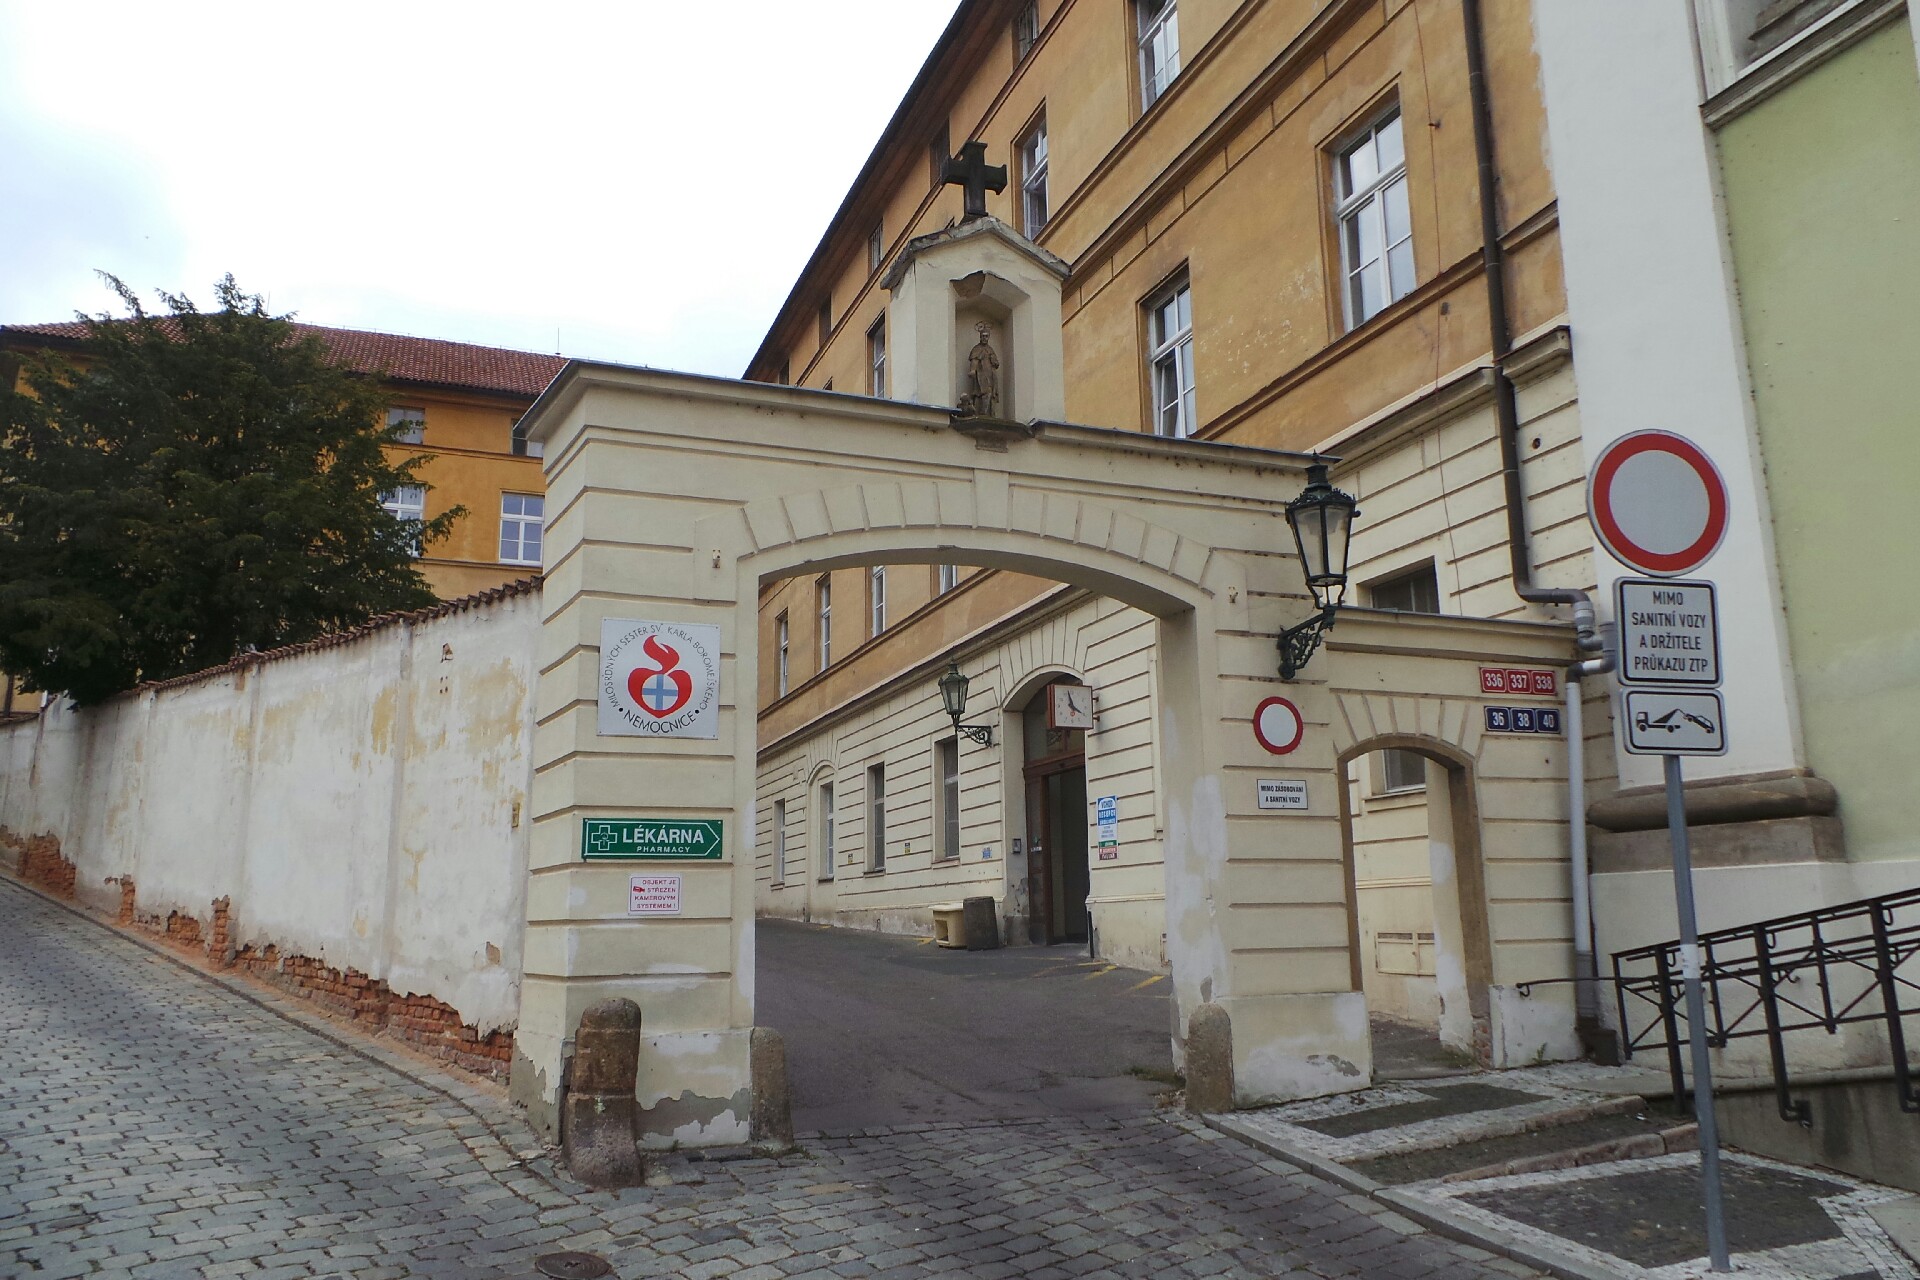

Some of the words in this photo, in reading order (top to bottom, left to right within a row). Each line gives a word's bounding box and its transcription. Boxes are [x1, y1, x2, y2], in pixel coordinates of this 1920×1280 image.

[1652, 590, 1684, 606] MIMO
[1631, 610, 1676, 627] SANITNÍ
[1679, 613, 1706, 628] VOZY
[619, 626, 648, 646] SESTER
[667, 626, 693, 644] KARLA
[1639, 634, 1648, 648] A
[1650, 632, 1702, 650] DRŽITELE
[1634, 653, 1686, 671] PRŮKAZU
[1689, 658, 1709, 672] ZTP
[1485, 673, 1503, 687] 336
[1510, 674, 1527, 688] 337
[1535, 676, 1553, 690] 338
[623, 709, 697, 733] NEMOCNICE
[1492, 712, 1505, 726] 36
[1517, 713, 1530, 727] 38
[1543, 714, 1555, 728] 40
[622, 825, 704, 844] LÉKÁRNA
